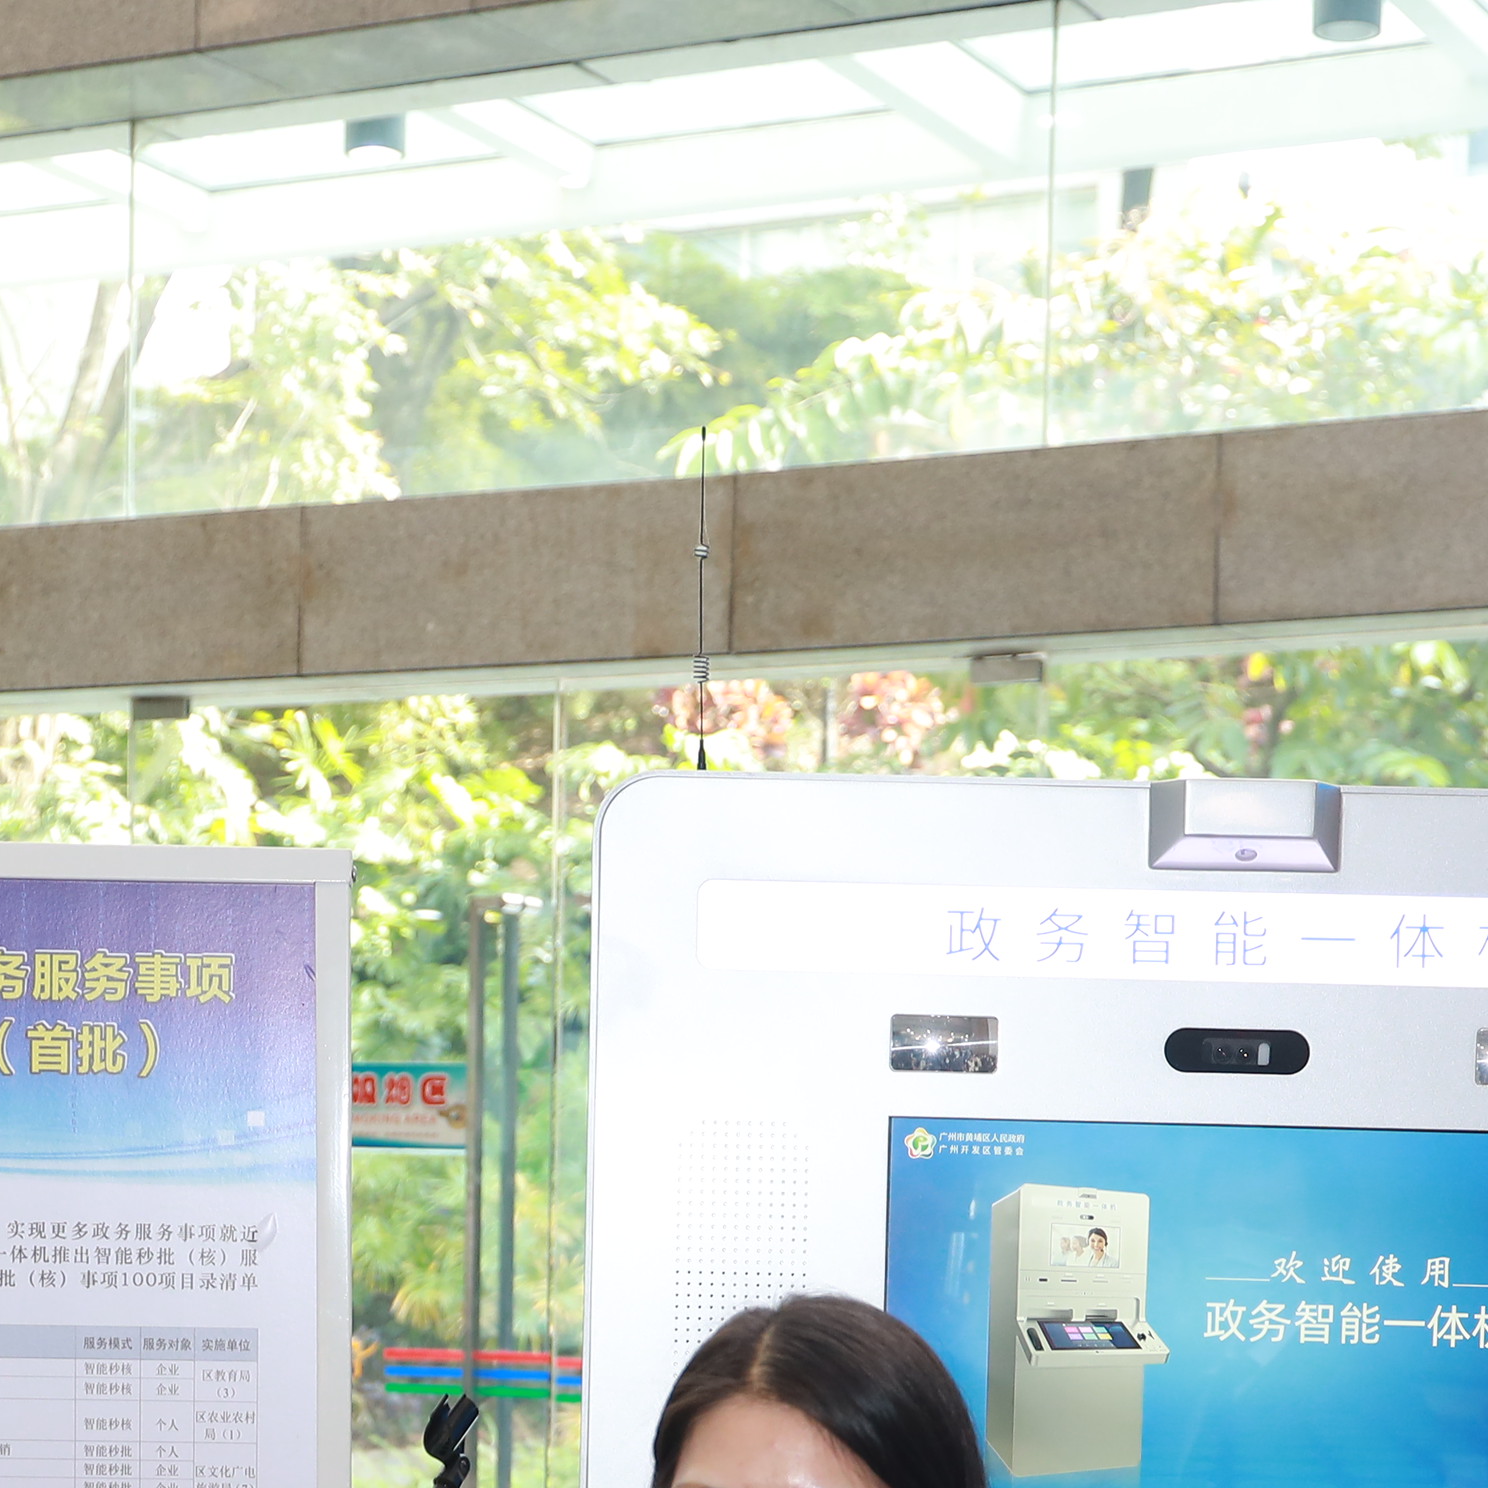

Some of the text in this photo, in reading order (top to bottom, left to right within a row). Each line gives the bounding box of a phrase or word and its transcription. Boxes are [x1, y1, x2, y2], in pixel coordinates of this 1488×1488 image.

[939, 1132, 1025, 1143] 广州市黄埔区人民政府
[939, 1145, 1024, 1156] 广州开发区管委会
[1271, 1251, 1451, 1288] 欢迎使用
[83, 1336, 132, 1350] 服务模式
[143, 1338, 192, 1352] 服务对象
[202, 1339, 250, 1353] 实施单位
[202, 1369, 250, 1383] 区教育局
